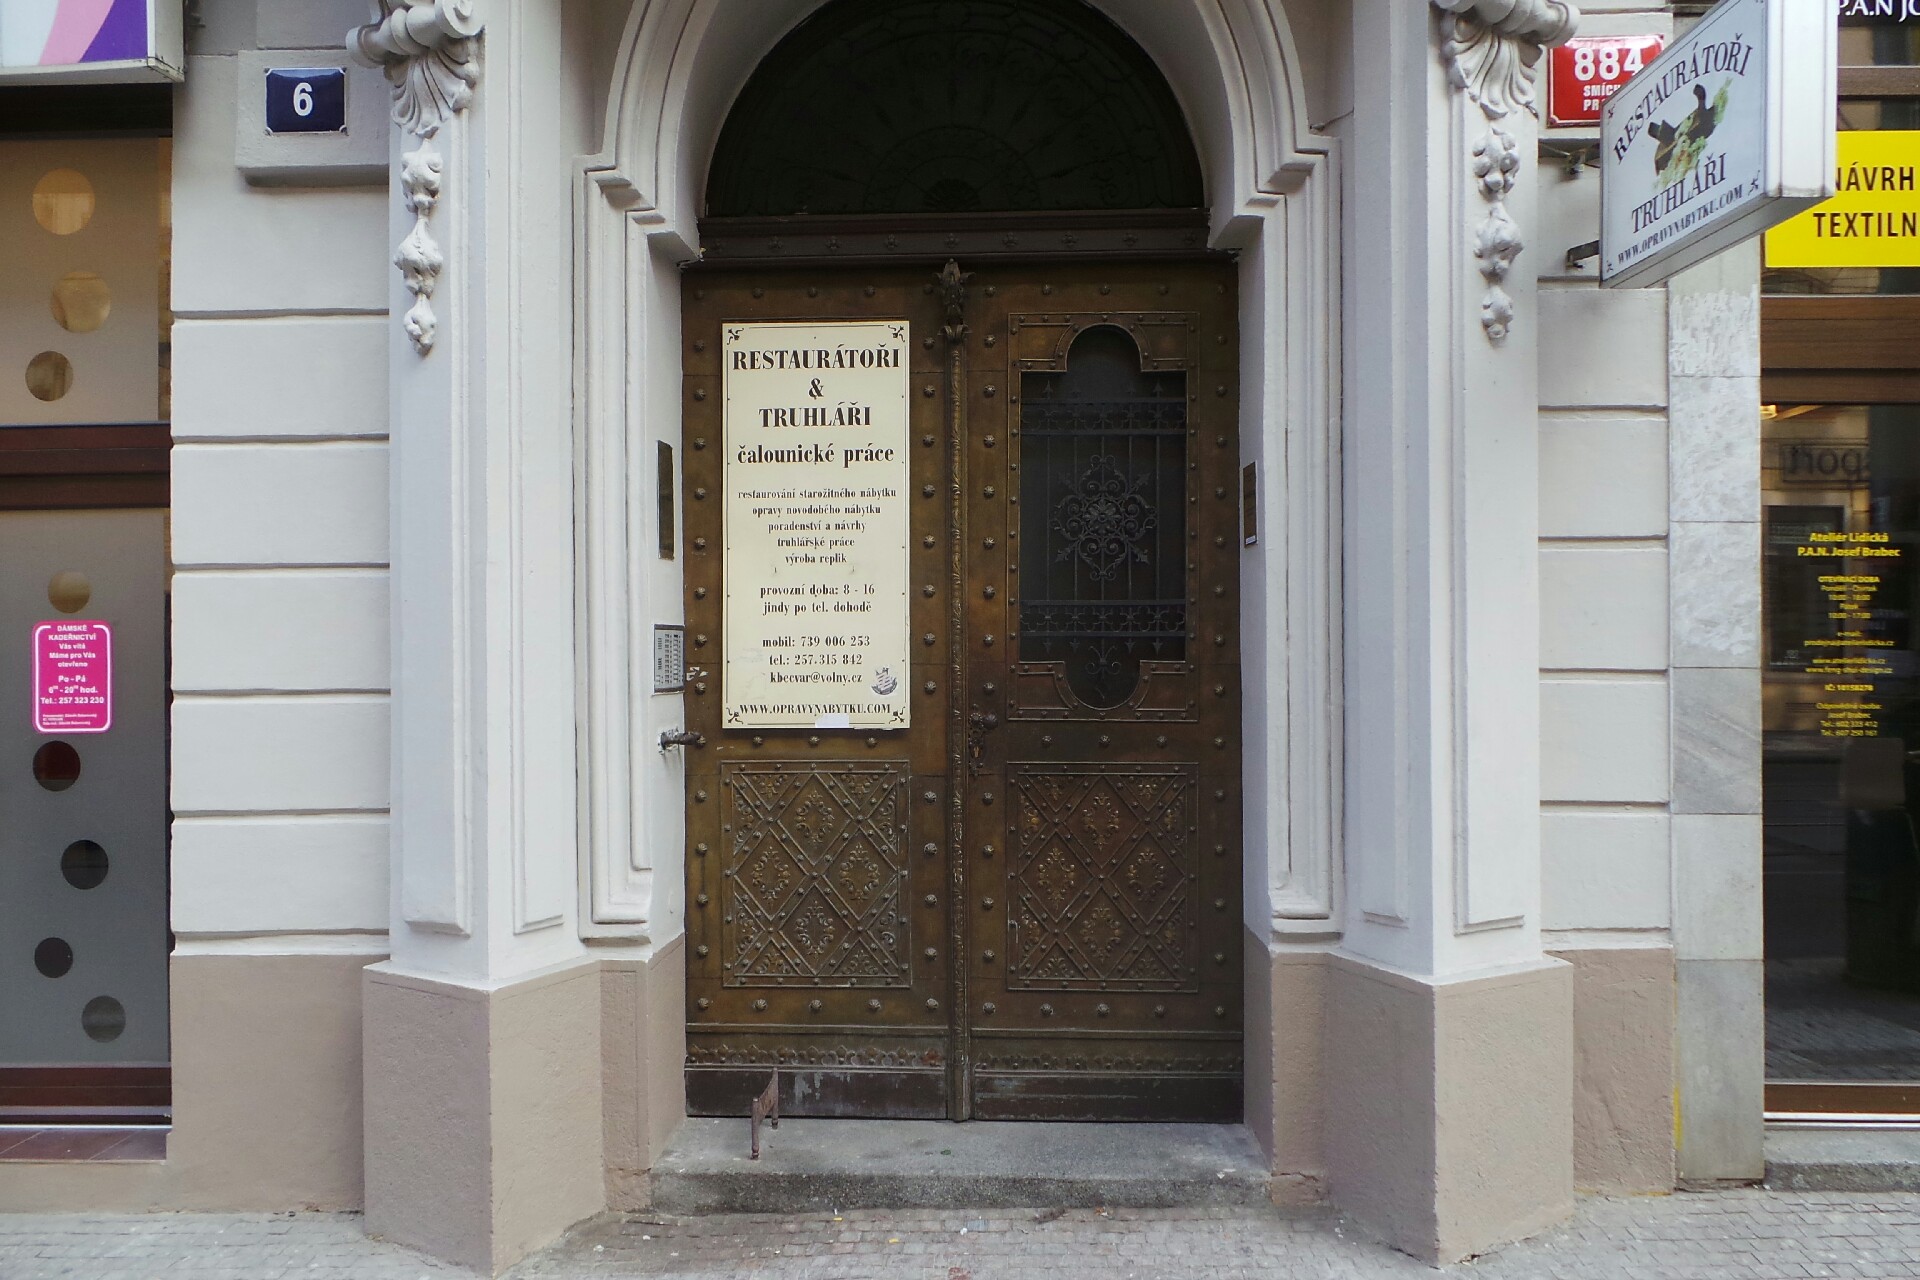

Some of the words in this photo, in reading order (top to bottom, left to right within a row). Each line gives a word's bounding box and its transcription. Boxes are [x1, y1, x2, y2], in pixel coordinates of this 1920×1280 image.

[1574, 47, 1644, 81] 884
[293, 82, 313, 117] 6
[1613, 33, 1753, 165] RESTAURÁTOŘI
[1632, 153, 1726, 233] TRUHLÁŘI
[1618, 184, 1743, 265] WWW.OPRAVYNABYTKU.COM
[1813, 212, 1916, 237] TEXTILN
[733, 344, 899, 370] RESTAURÁTOŘI
[809, 378, 824, 398] &
[759, 402, 870, 427] TRUHLÁŘI
[738, 443, 835, 463] čalounické
[843, 443, 894, 468] práce
[738, 488, 795, 499] restaurování
[799, 488, 856, 498] starožitného
[860, 487, 897, 500] nábytku
[752, 507, 782, 518] opravy
[786, 504, 841, 514] novodobého
[844, 504, 881, 517] nábytku
[768, 520, 822, 534] poradenství
[834, 520, 866, 533] návrhy
[777, 536, 825, 547] truhlářské
[829, 537, 855, 549] práce
[1809, 532, 1847, 542] Ateliér
[1849, 532, 1889, 542] Lidická
[785, 553, 816, 565] výroba
[819, 552, 847, 565] replik
[1831, 547, 1861, 556] Josef
[1862, 547, 1901, 556] Brabec
[760, 584, 805, 598] provozní
[809, 584, 839, 595] doba:
[843, 584, 850, 595] 8
[863, 584, 875, 595] 16
[762, 602, 789, 616] jindy
[794, 604, 807, 615] po
[812, 602, 828, 612] tel.
[833, 601, 872, 613] dohodě
[762, 636, 795, 647] mobil:
[801, 636, 820, 647] 739
[825, 636, 845, 647] 006
[850, 636, 870, 647] 253
[769, 654, 790, 665] tel.:
[842, 654, 862, 665] 842
[770, 672, 862, 685] kbecvar@volny.cz
[80, 686, 98, 694] hod.
[739, 704, 890, 714] WWW.OPRAVYNABYTKU.COM
